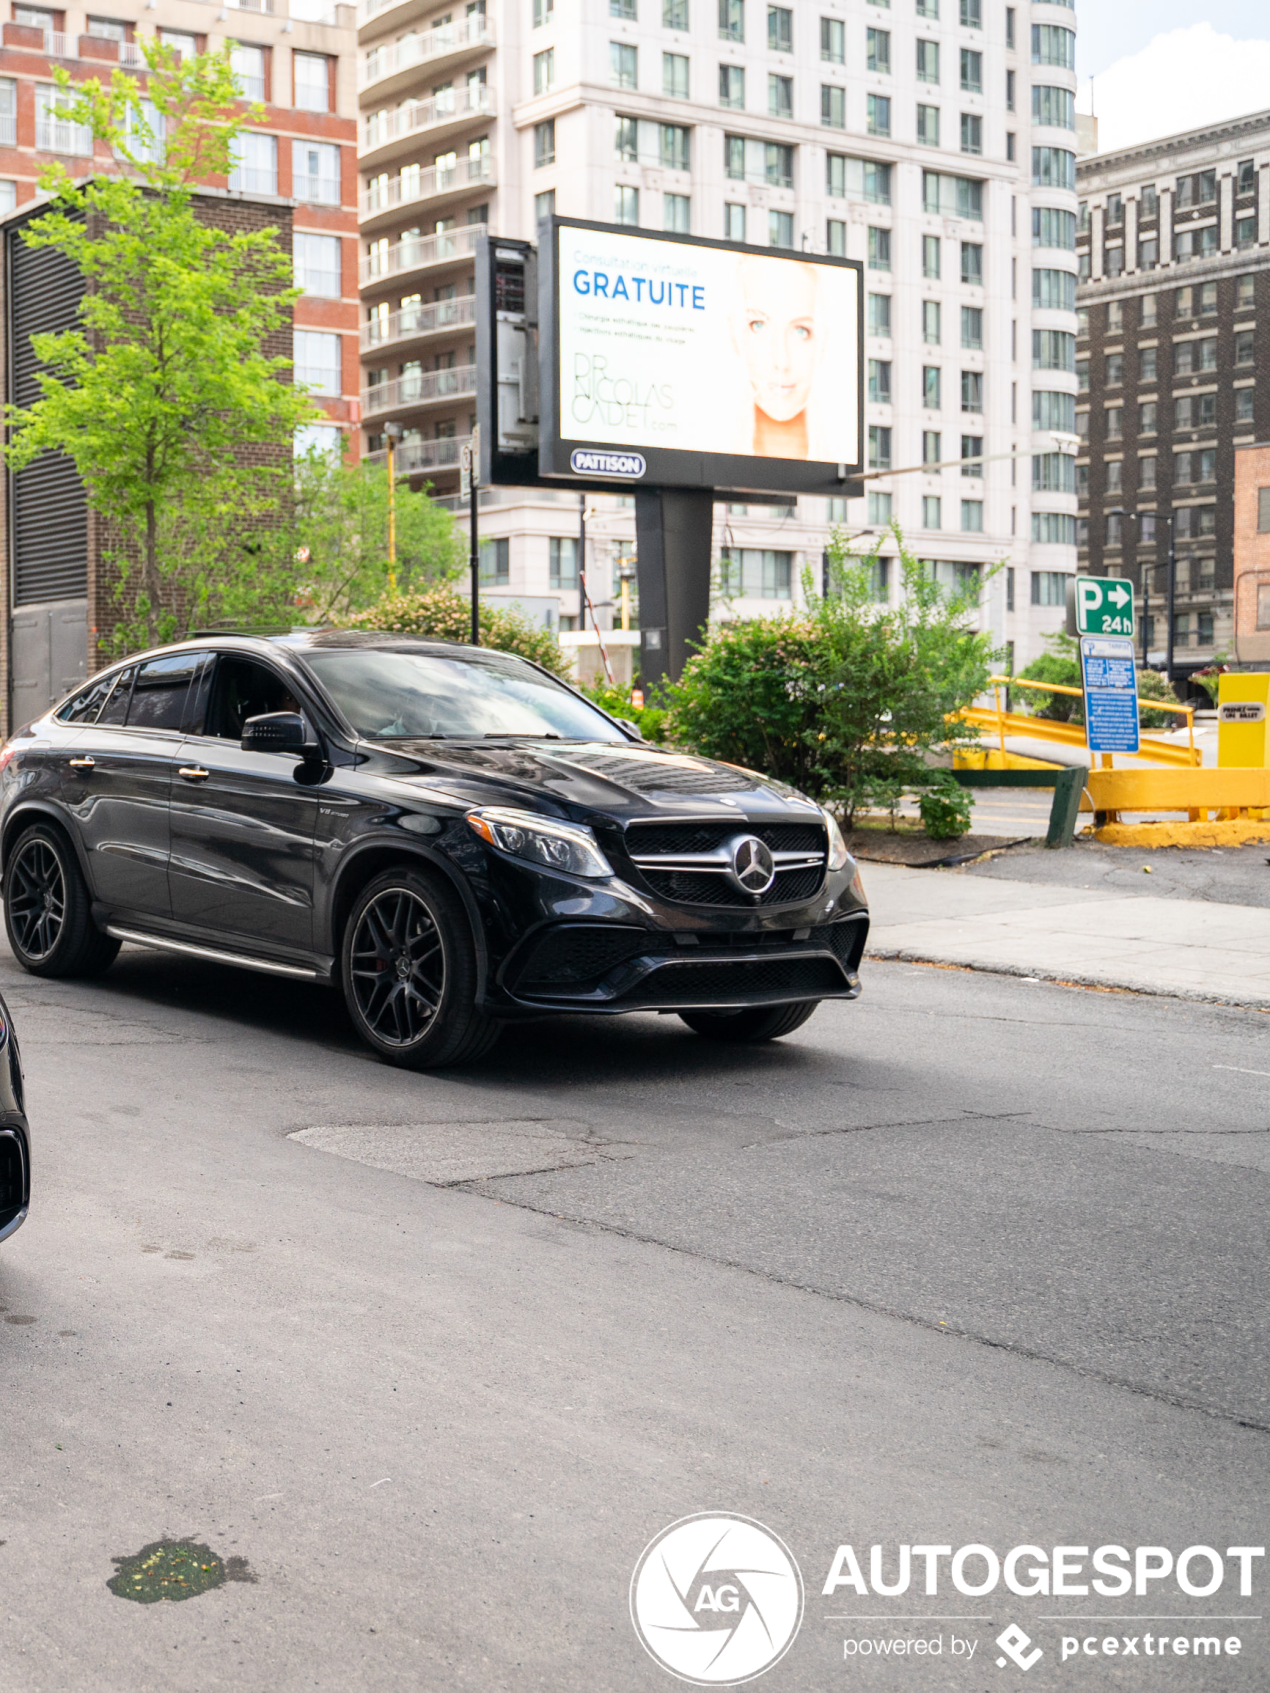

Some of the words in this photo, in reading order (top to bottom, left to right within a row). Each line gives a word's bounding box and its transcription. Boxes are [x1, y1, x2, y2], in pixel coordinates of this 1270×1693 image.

[573, 269, 705, 310] GRATUITE
[574, 376, 674, 410] NICOLAS
[575, 453, 640, 474] PATTISON
[1078, 581, 1103, 630] P
[1102, 615, 1132, 634] 24h
